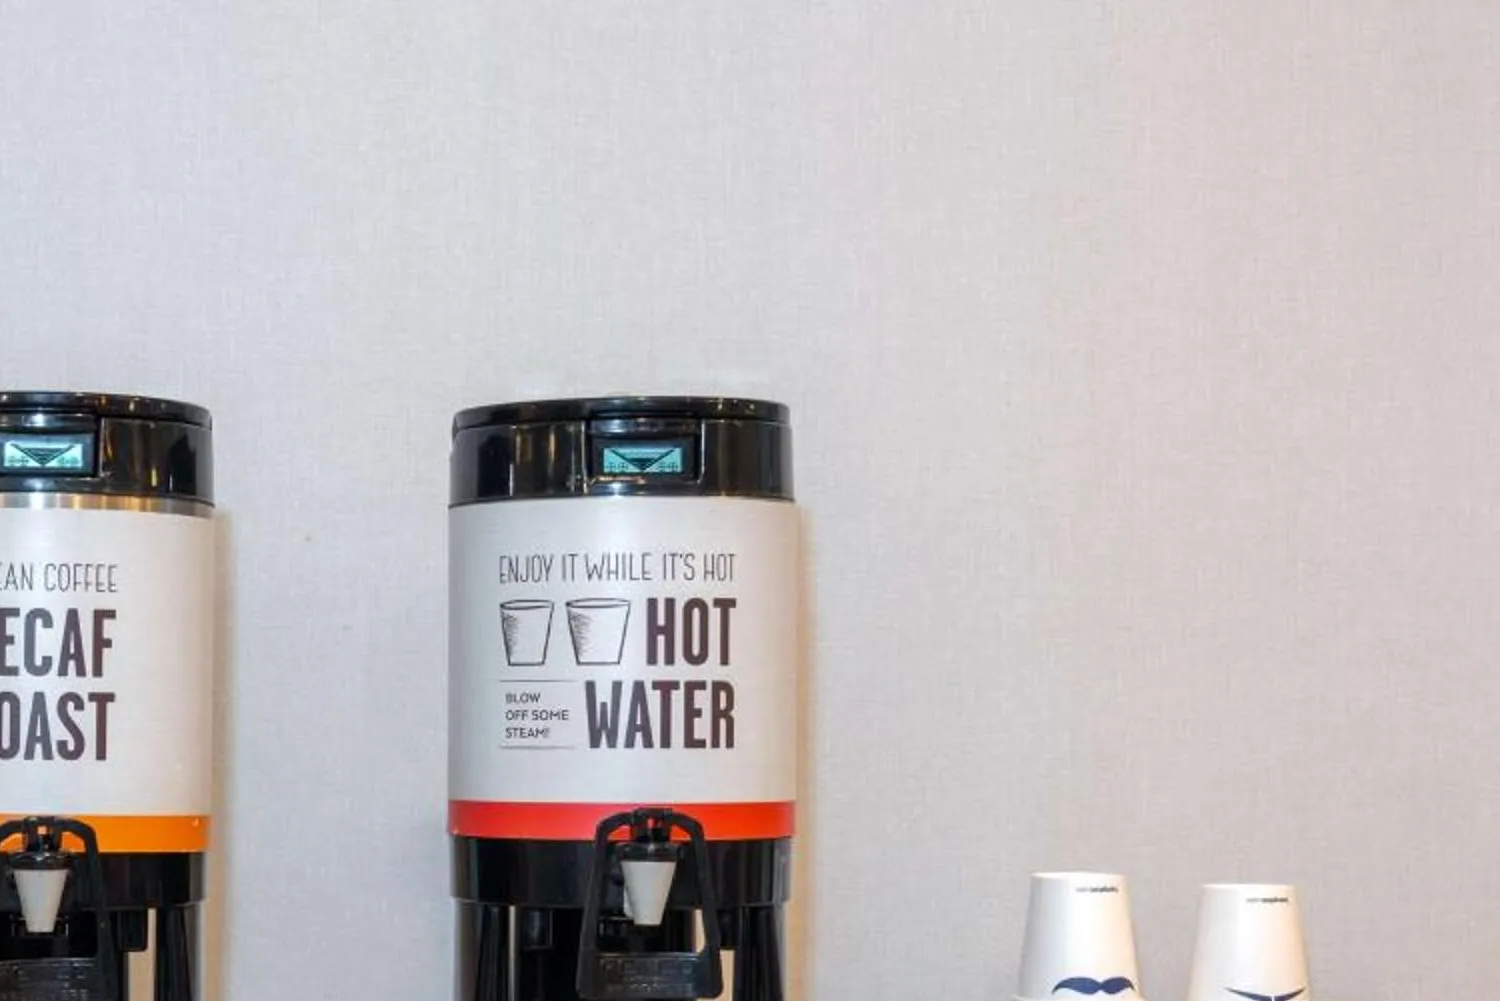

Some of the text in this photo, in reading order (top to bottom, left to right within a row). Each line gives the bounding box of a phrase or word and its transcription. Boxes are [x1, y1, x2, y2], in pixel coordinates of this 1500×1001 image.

[44, 563, 118, 592] COFFEE
[499, 552, 736, 583] ENJOY IT WHILE IT'S HOT
[646, 598, 736, 665] HOT
[505, 692, 541, 704] BLOW
[505, 709, 569, 721] OFF SOME
[585, 680, 735, 749] WATER
